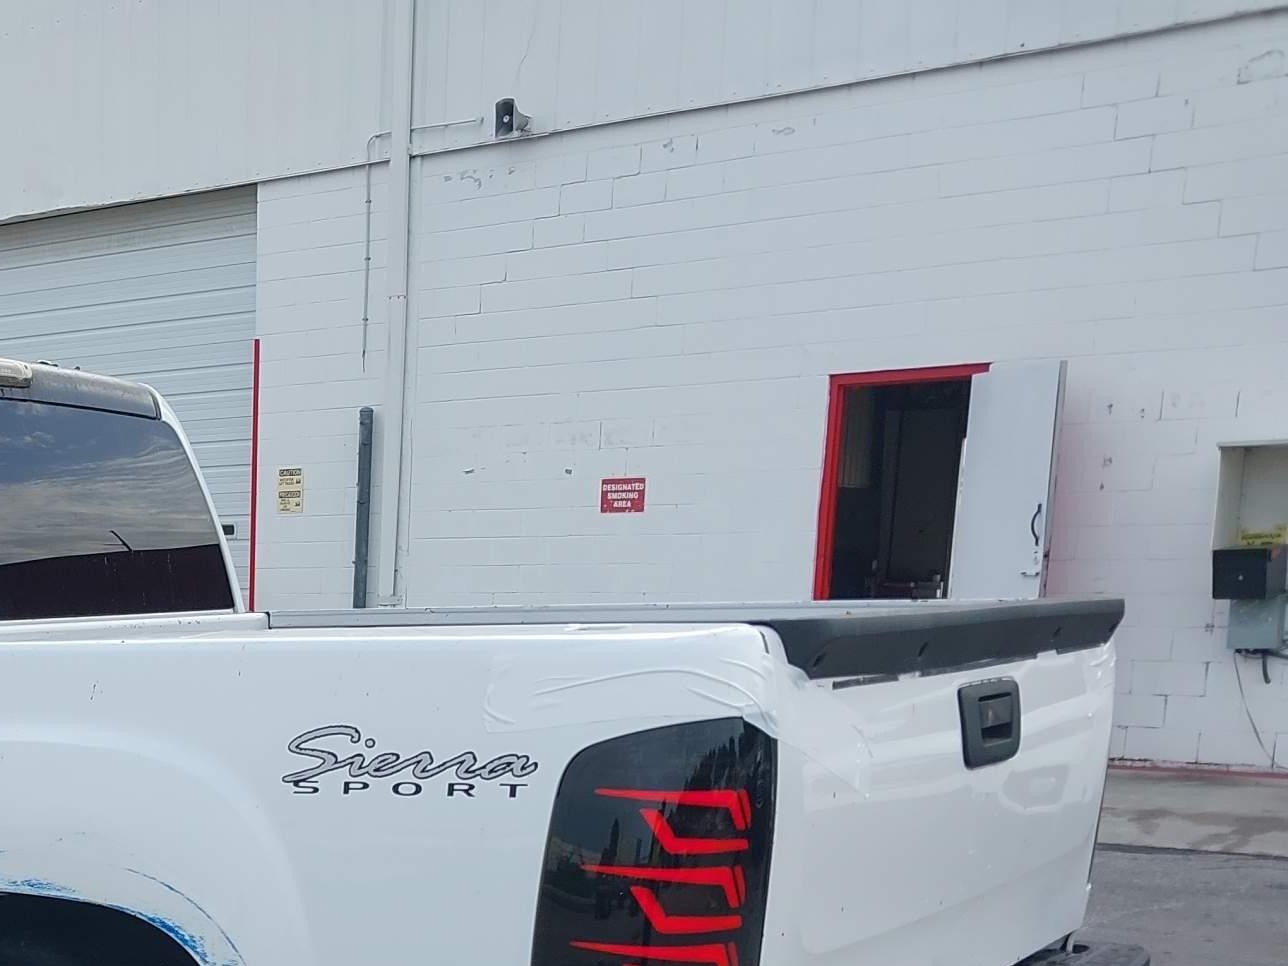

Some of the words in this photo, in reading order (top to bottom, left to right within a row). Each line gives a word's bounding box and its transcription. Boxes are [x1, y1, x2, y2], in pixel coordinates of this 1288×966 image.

[603, 483, 644, 491] DESIGNATED
[282, 725, 538, 782] Sierra
[293, 780, 528, 798] SPORT
